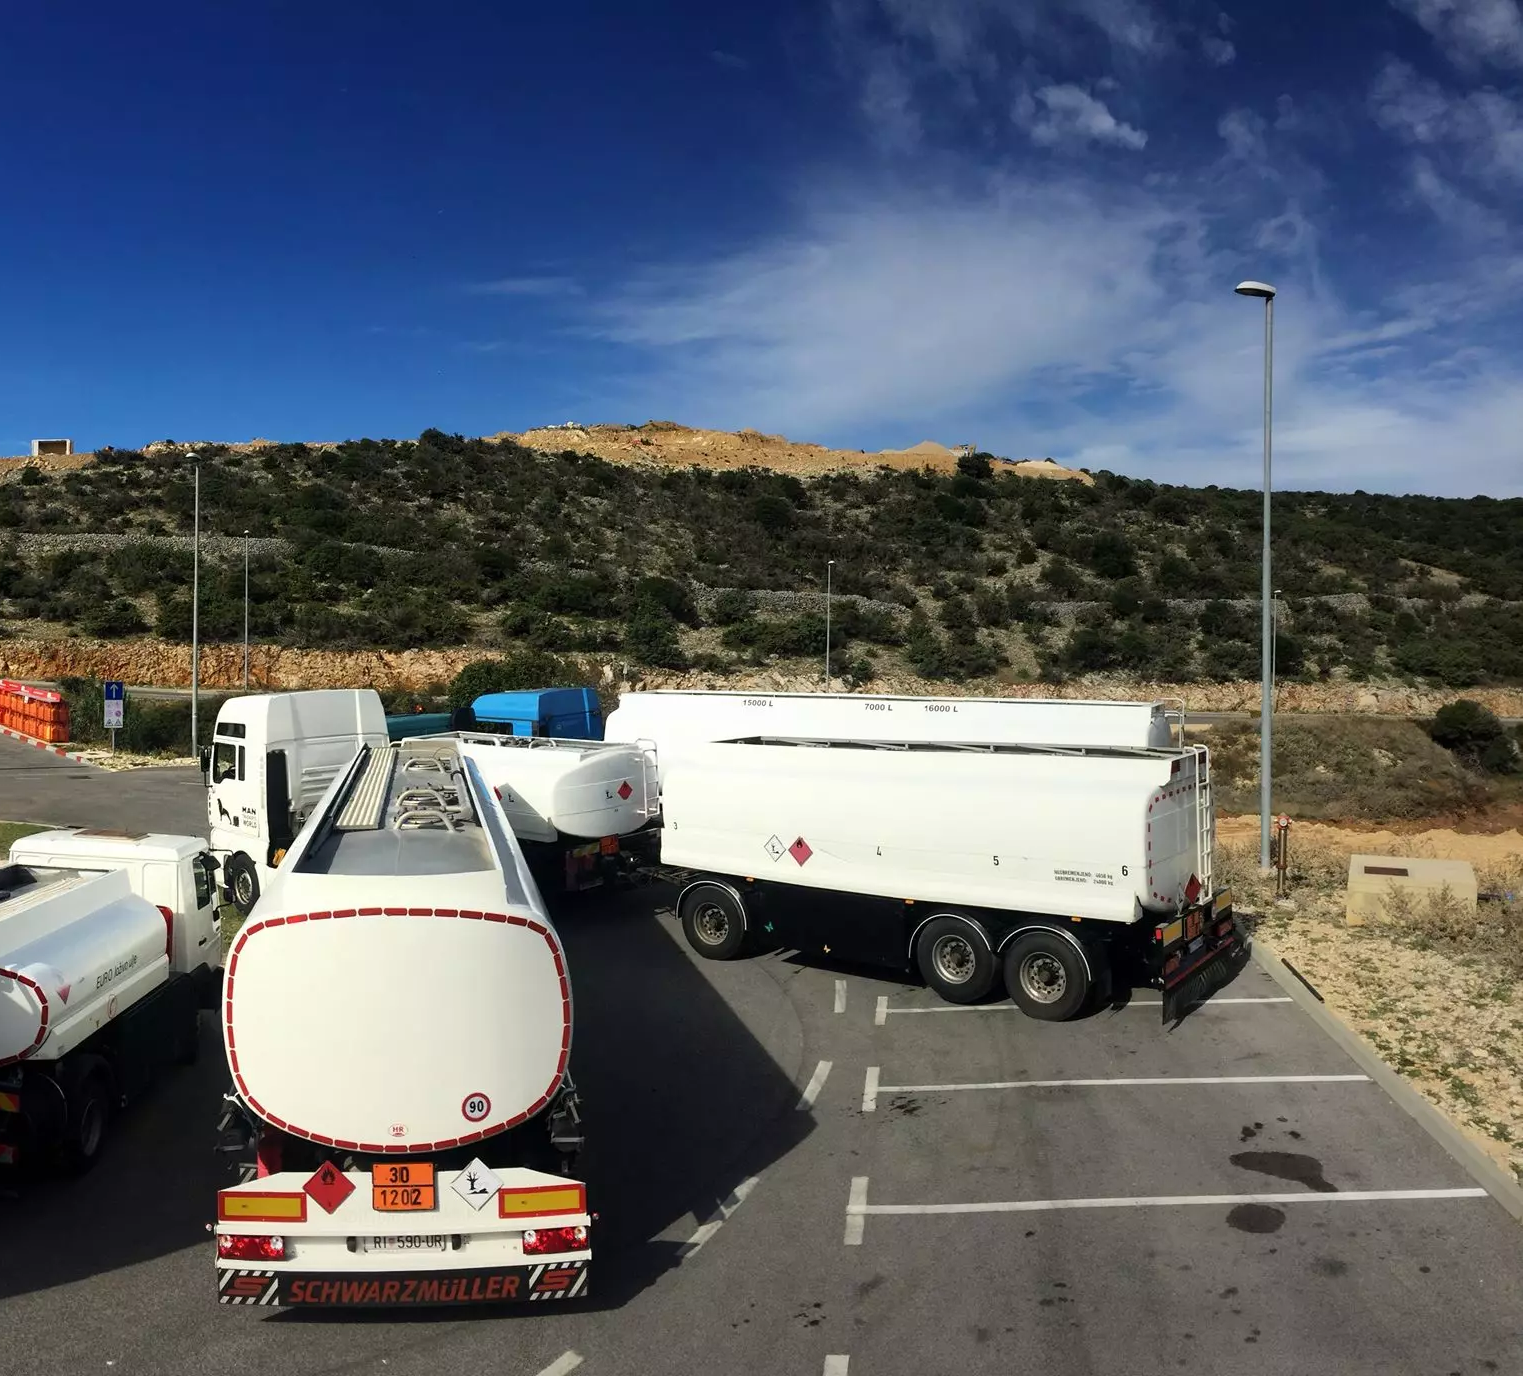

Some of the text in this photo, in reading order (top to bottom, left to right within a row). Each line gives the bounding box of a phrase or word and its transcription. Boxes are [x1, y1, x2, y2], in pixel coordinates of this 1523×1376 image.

[864, 703, 885, 711] 7000
[241, 806, 256, 815] MAN
[673, 821, 678, 830] 3
[876, 846, 882, 856] 4
[993, 855, 999, 866] 5
[1121, 865, 1129, 877] 6
[96, 968, 113, 989] EURO
[469, 1100, 484, 1113] 90
[389, 1166, 409, 1183] 30
[380, 1188, 422, 1206] 1202
[373, 1235, 387, 1248] RI
[288, 1276, 521, 1303] SCHWARZMÜLLER
